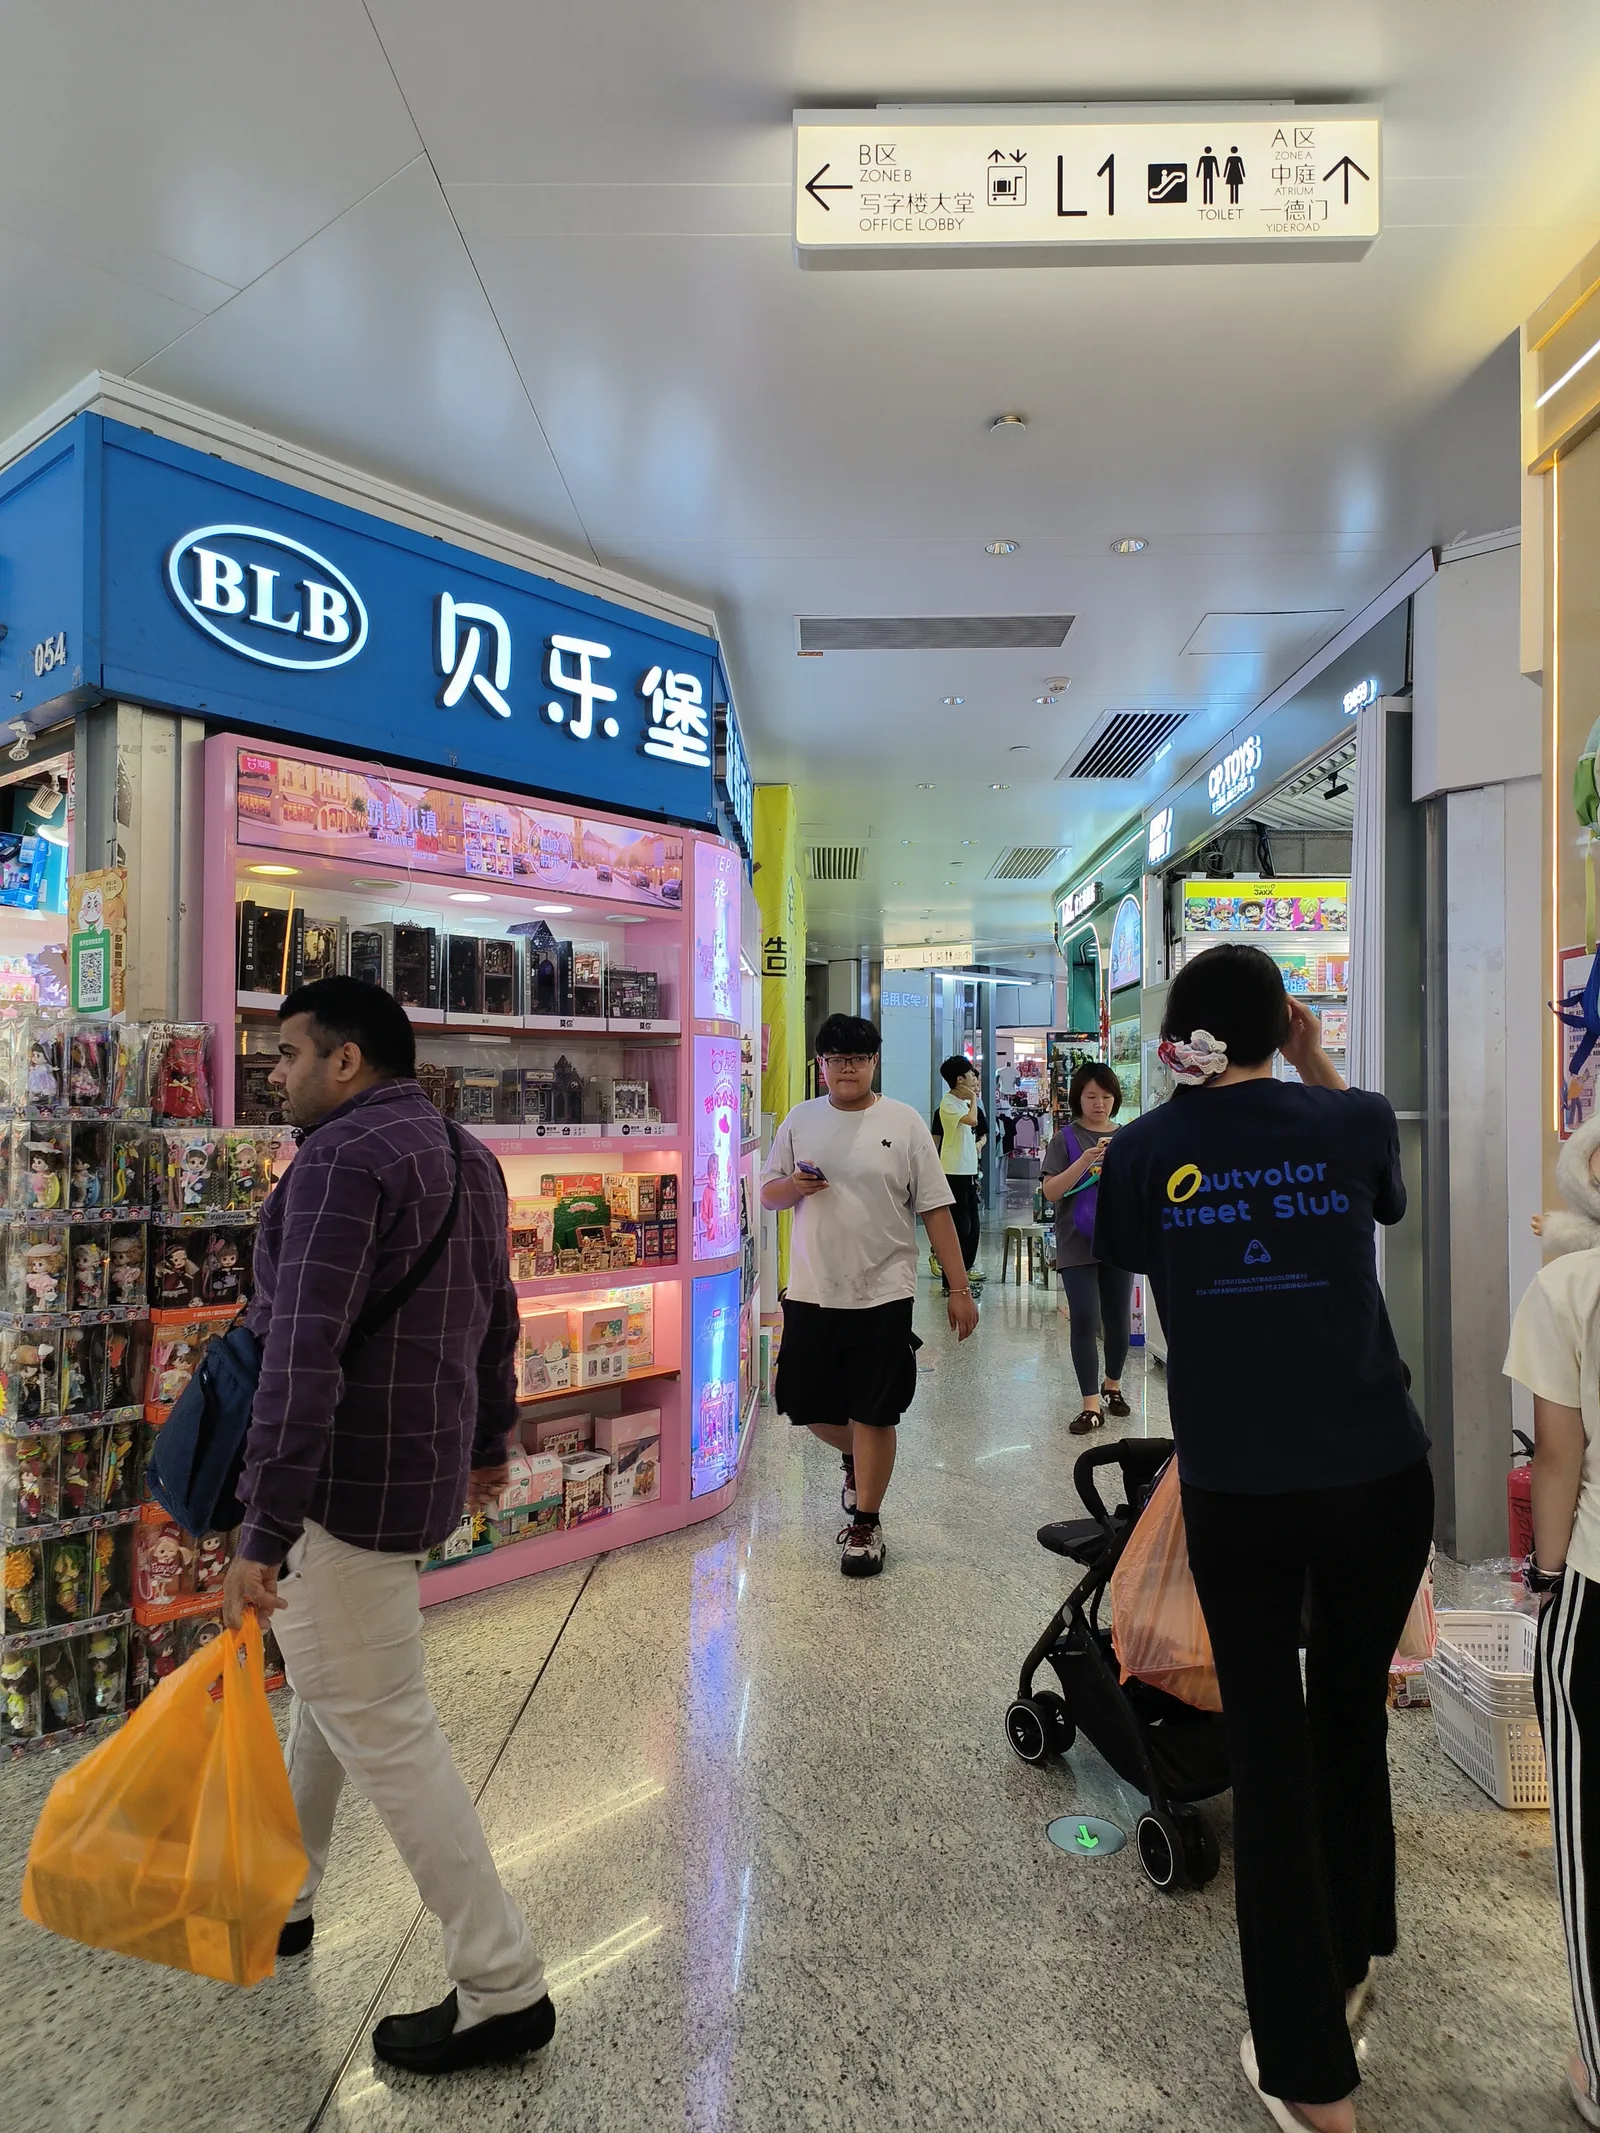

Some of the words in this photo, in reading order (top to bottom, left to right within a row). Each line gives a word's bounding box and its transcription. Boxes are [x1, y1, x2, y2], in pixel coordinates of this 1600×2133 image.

[859, 144, 897, 166] B区
[1274, 151, 1302, 160] ZONE
[1304, 151, 1313, 159] A
[860, 168, 901, 182] ZONE
[904, 169, 912, 182] B
[1057, 153, 1116, 217] L1
[1271, 164, 1316, 185] 中庭
[1274, 186, 1314, 195] ATRIUM
[860, 193, 975, 215] 写字楼大堂
[1197, 208, 1244, 220] TOILET
[1259, 200, 1329, 221] 一德门
[859, 218, 914, 232] OFFICE
[919, 217, 965, 231] LOBBY
[1266, 223, 1291, 232] YIDE
[1292, 222, 1320, 231] ROAD
[191, 545, 352, 645] BLB
[35, 632, 67, 677] 054
[440, 591, 711, 768] 贝乐堡
[922, 952, 933, 963] L1
[1273, 1190, 1349, 1219] Slub
